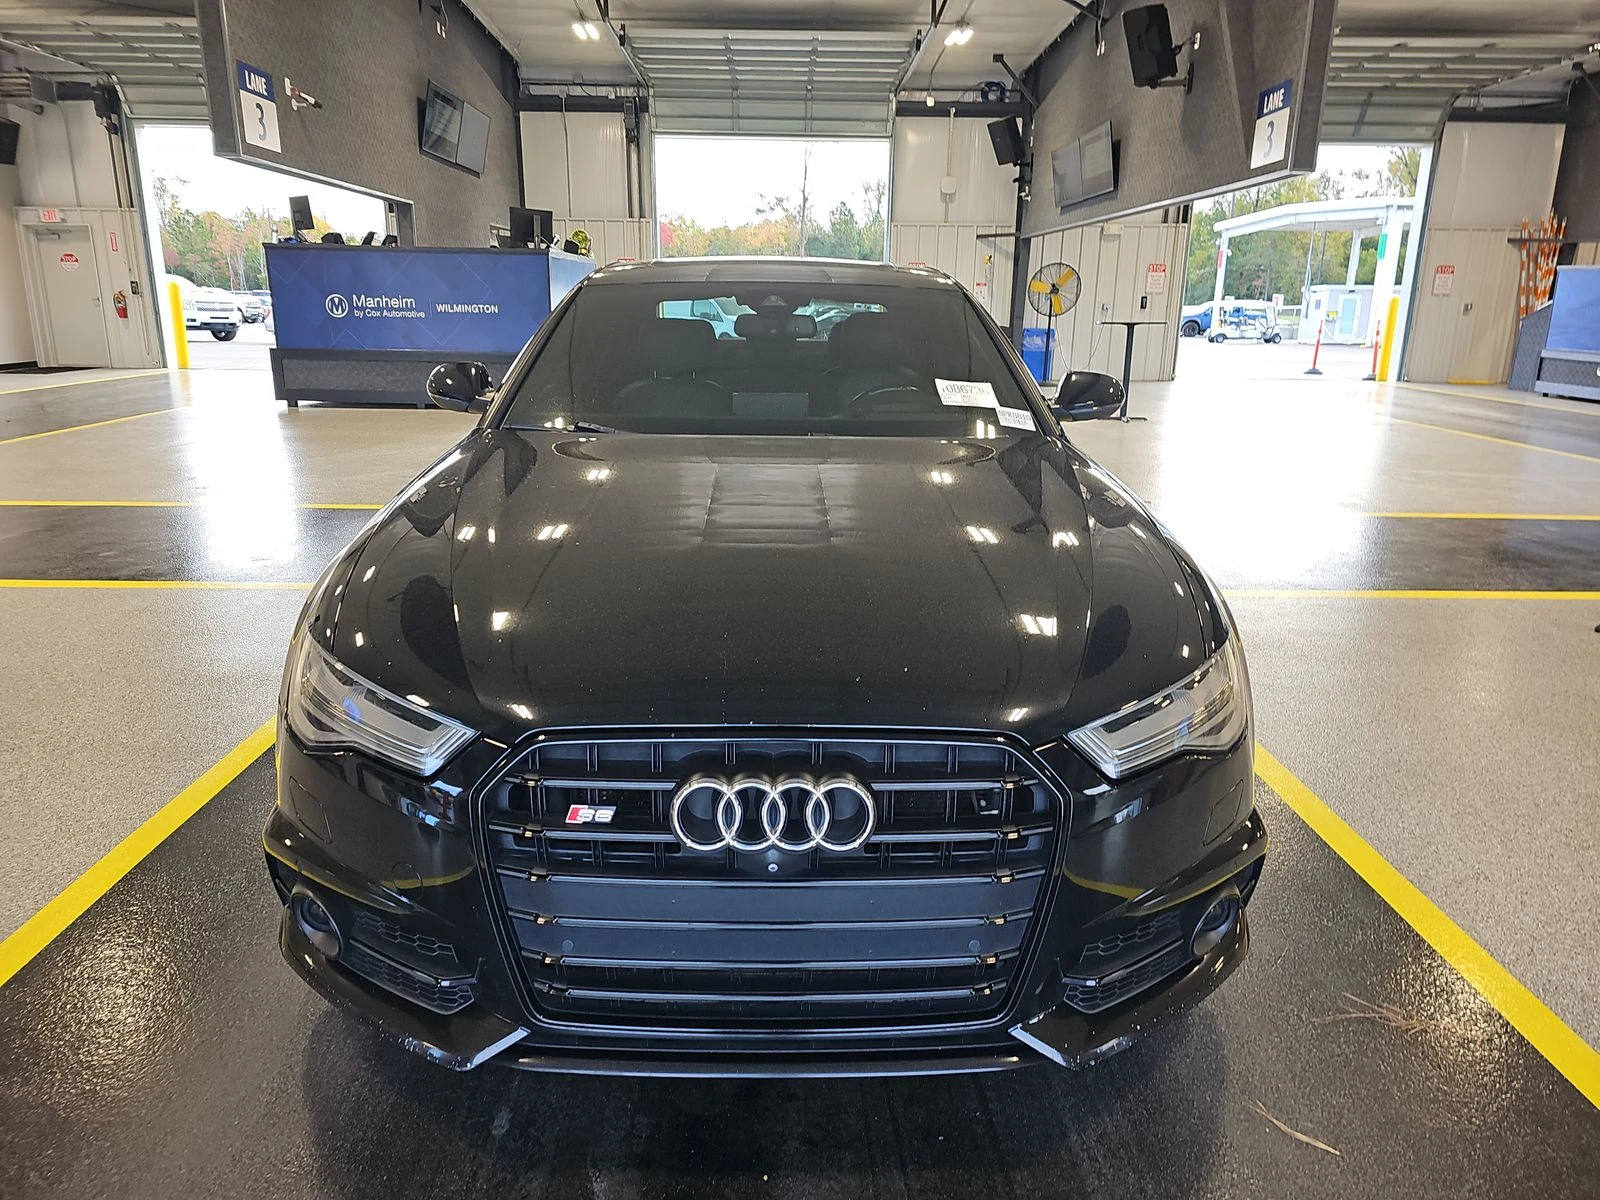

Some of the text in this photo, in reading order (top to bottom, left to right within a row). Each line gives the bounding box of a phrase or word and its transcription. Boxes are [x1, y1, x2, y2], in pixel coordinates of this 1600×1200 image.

[245, 70, 268, 96] LANE
[1263, 87, 1285, 114] LANE
[255, 102, 267, 141] 3
[1263, 120, 1275, 158] 3
[1149, 264, 1166, 273] STOP
[1436, 265, 1455, 274] STOP
[352, 294, 416, 309] Manheim
[435, 303, 499, 314] WILMINGTON
[354, 309, 426, 319] by Cox Automotive
